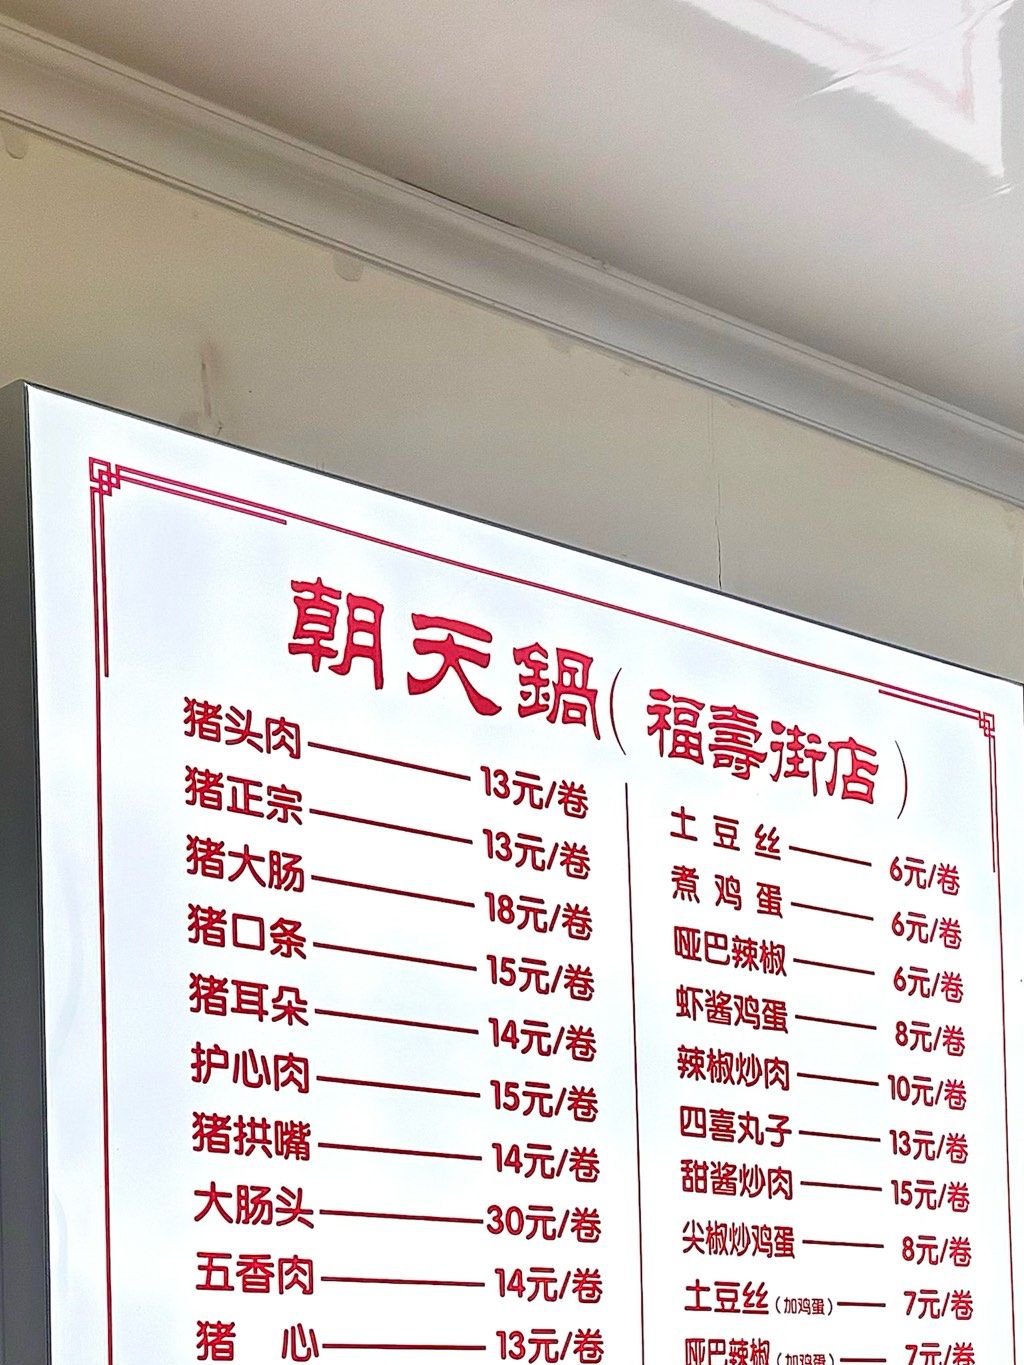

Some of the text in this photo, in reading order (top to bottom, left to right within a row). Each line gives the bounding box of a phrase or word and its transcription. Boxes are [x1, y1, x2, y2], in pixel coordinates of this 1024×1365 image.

[184, 697, 589, 820] 猪头肉 13元/卷
[185, 765, 591, 880] 猪正宗 13元/卷
[187, 834, 593, 940] 猪大肠 18元/卷
[890, 856, 960, 895] 6元/卷
[188, 903, 595, 1002] 猪口条 15元/卷
[674, 926, 964, 1003] 哑巴辣椒 6元/卷
[892, 912, 961, 950] 6元/卷
[189, 972, 597, 1062] 猪耳朵 14元/卷
[676, 984, 966, 1057] 虾酱鸡蛋 8元/卷
[191, 1041, 598, 1123] 护心肉 15元/卷
[677, 1044, 967, 1111] 辣椒炒肉 10元/卷
[192, 1112, 600, 1183] 猪拱嘴 14元/卷
[680, 1106, 968, 1164] 四喜丸子 13元/卷
[194, 1181, 602, 1244] 大肠头 30元/卷
[681, 1159, 970, 1213] 甜酱炒肉 15元/卷
[683, 1219, 972, 1267] 尖椒炒鸡蛋 8元/卷
[196, 1252, 603, 1303] 五香肉 14元/卷
[904, 1289, 973, 1320] 7元/卷
[496, 1328, 604, 1365] 13元/卷
